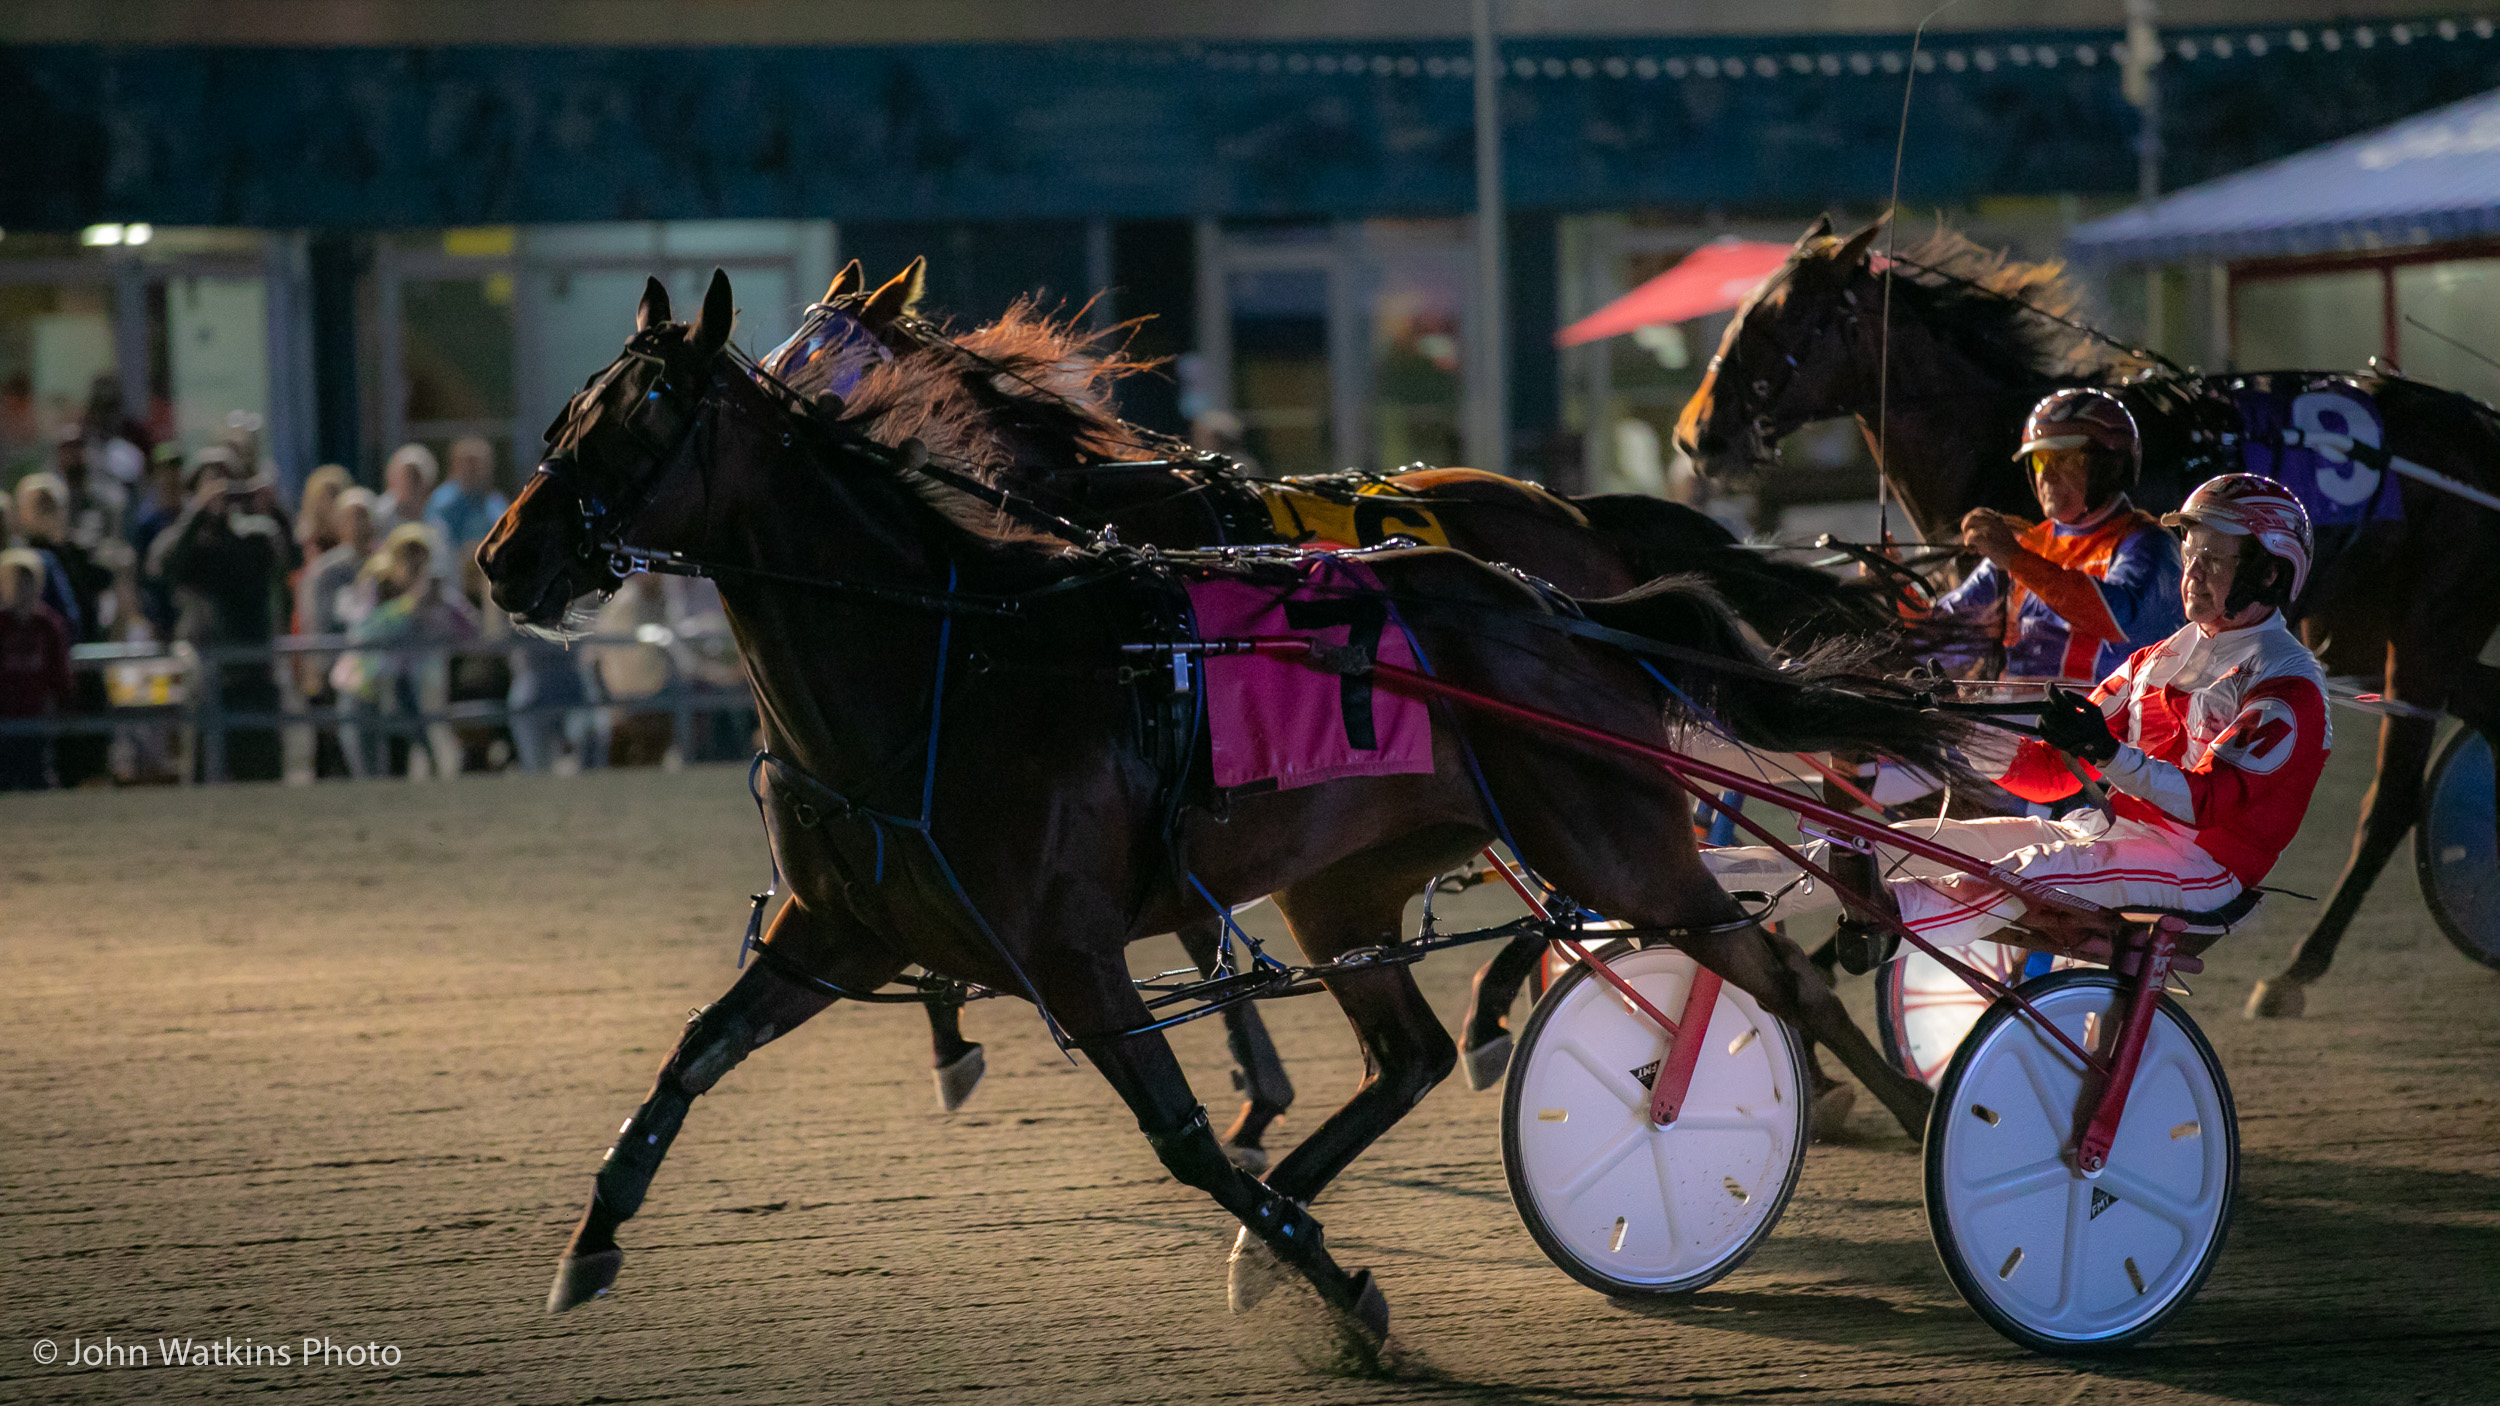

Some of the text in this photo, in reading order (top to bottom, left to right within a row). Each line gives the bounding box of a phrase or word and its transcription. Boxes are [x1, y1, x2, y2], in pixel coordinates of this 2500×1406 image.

[2292, 391, 2382, 506] 9
[1283, 596, 1388, 751] 7
[2214, 708, 2294, 760] M
[1636, 1063, 1659, 1079] FMT
[2091, 1195, 2111, 1217] FMT
